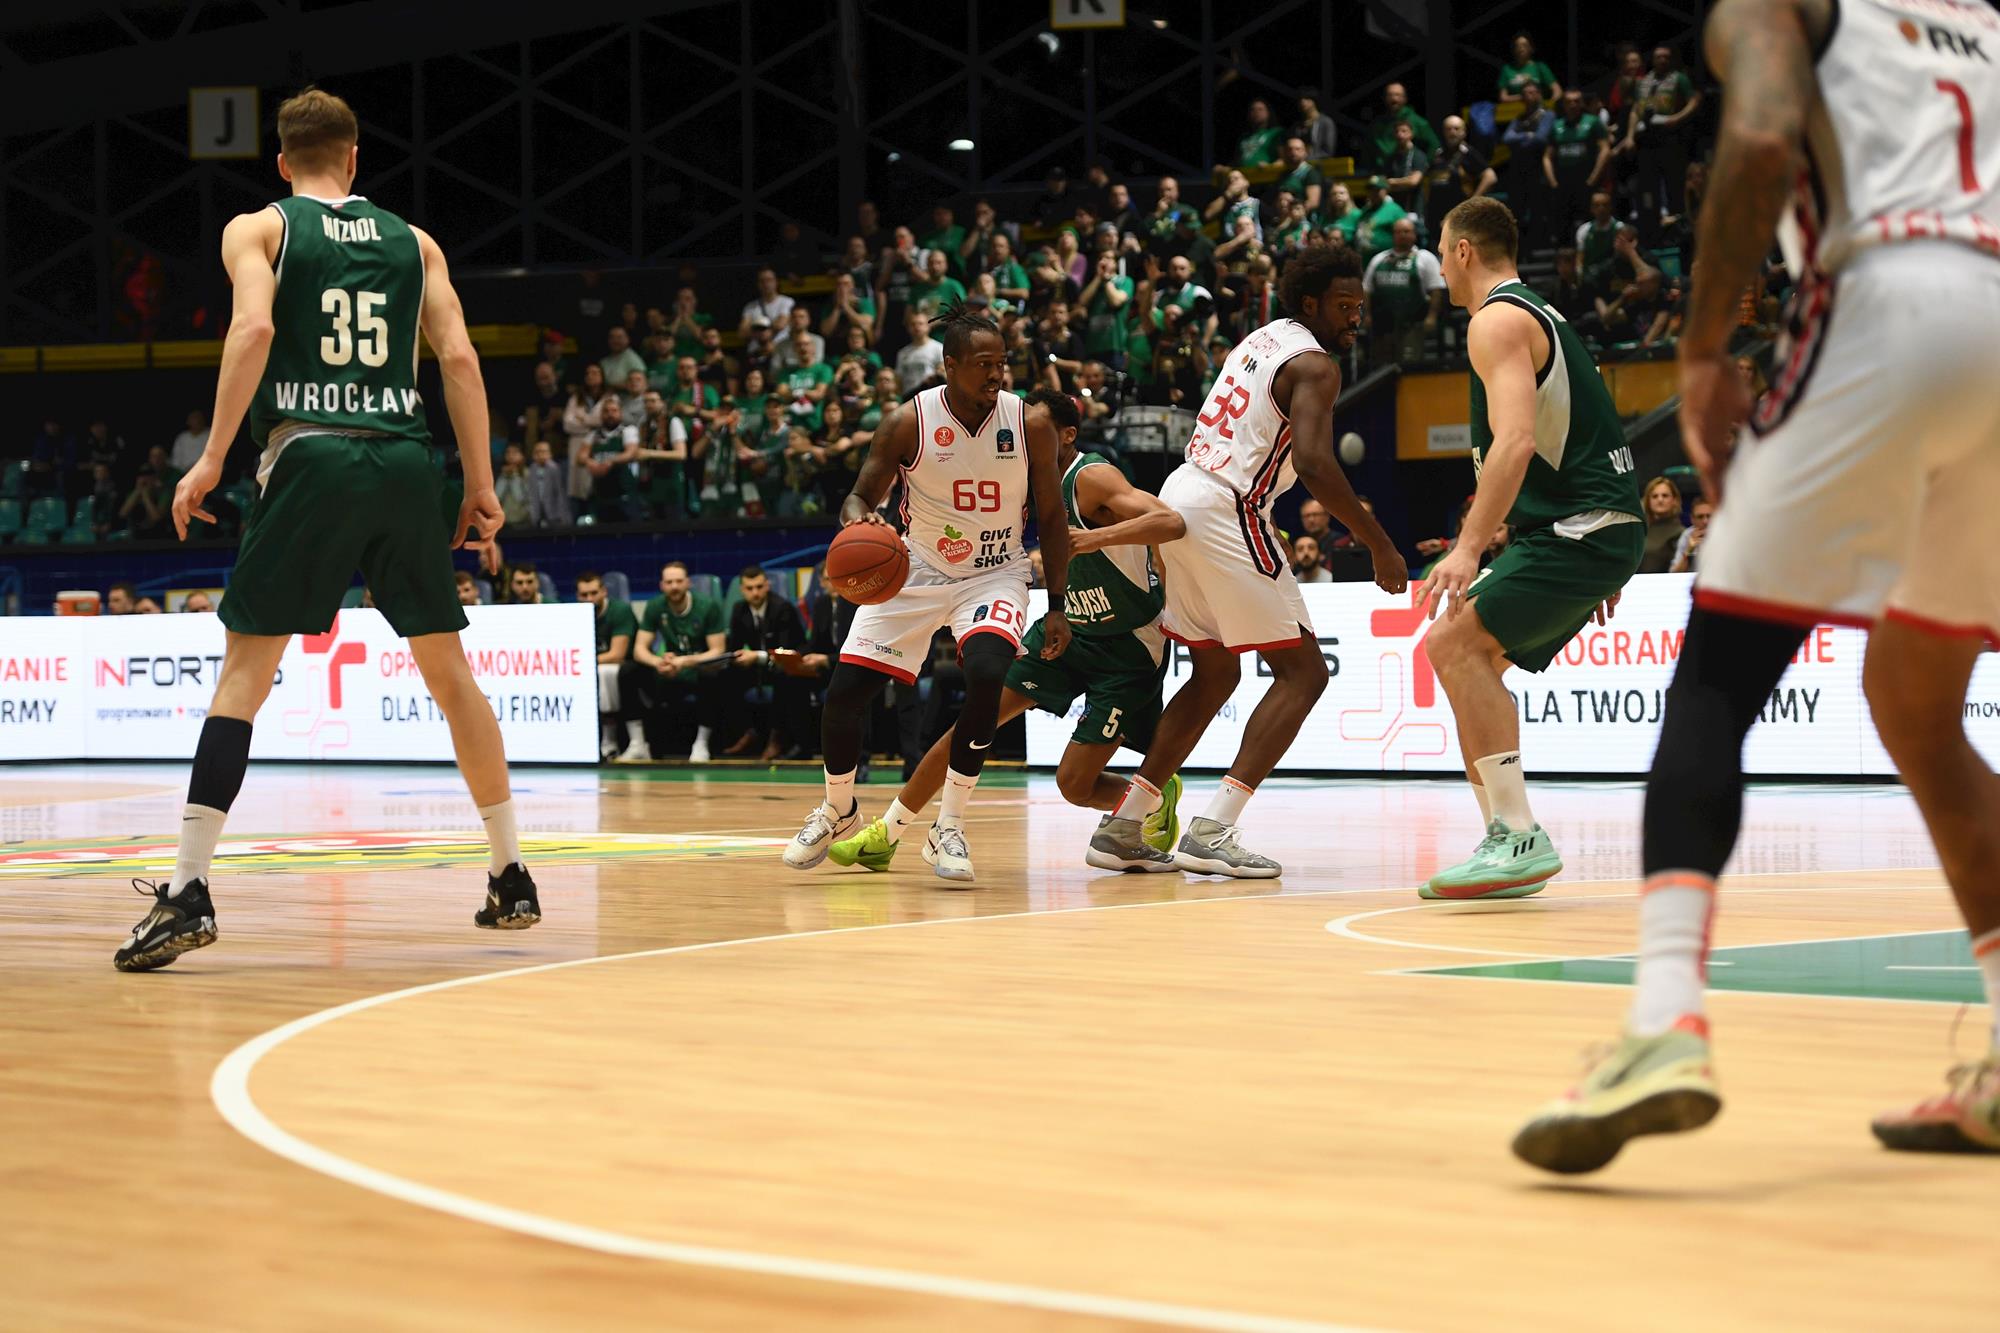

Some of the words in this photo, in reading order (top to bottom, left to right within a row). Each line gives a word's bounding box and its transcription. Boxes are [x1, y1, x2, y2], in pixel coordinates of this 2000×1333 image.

[214, 97, 235, 147] J
[320, 287, 389, 368] 35
[953, 479, 1001, 512] 69
[979, 527, 1013, 542] GIVE
[981, 543, 995, 556] IT
[999, 541, 1007, 554] A
[0, 657, 69, 682] ANIE
[382, 696, 420, 721] DLA
[511, 695, 574, 722] FIRMY
[1101, 707, 1123, 739] 5
